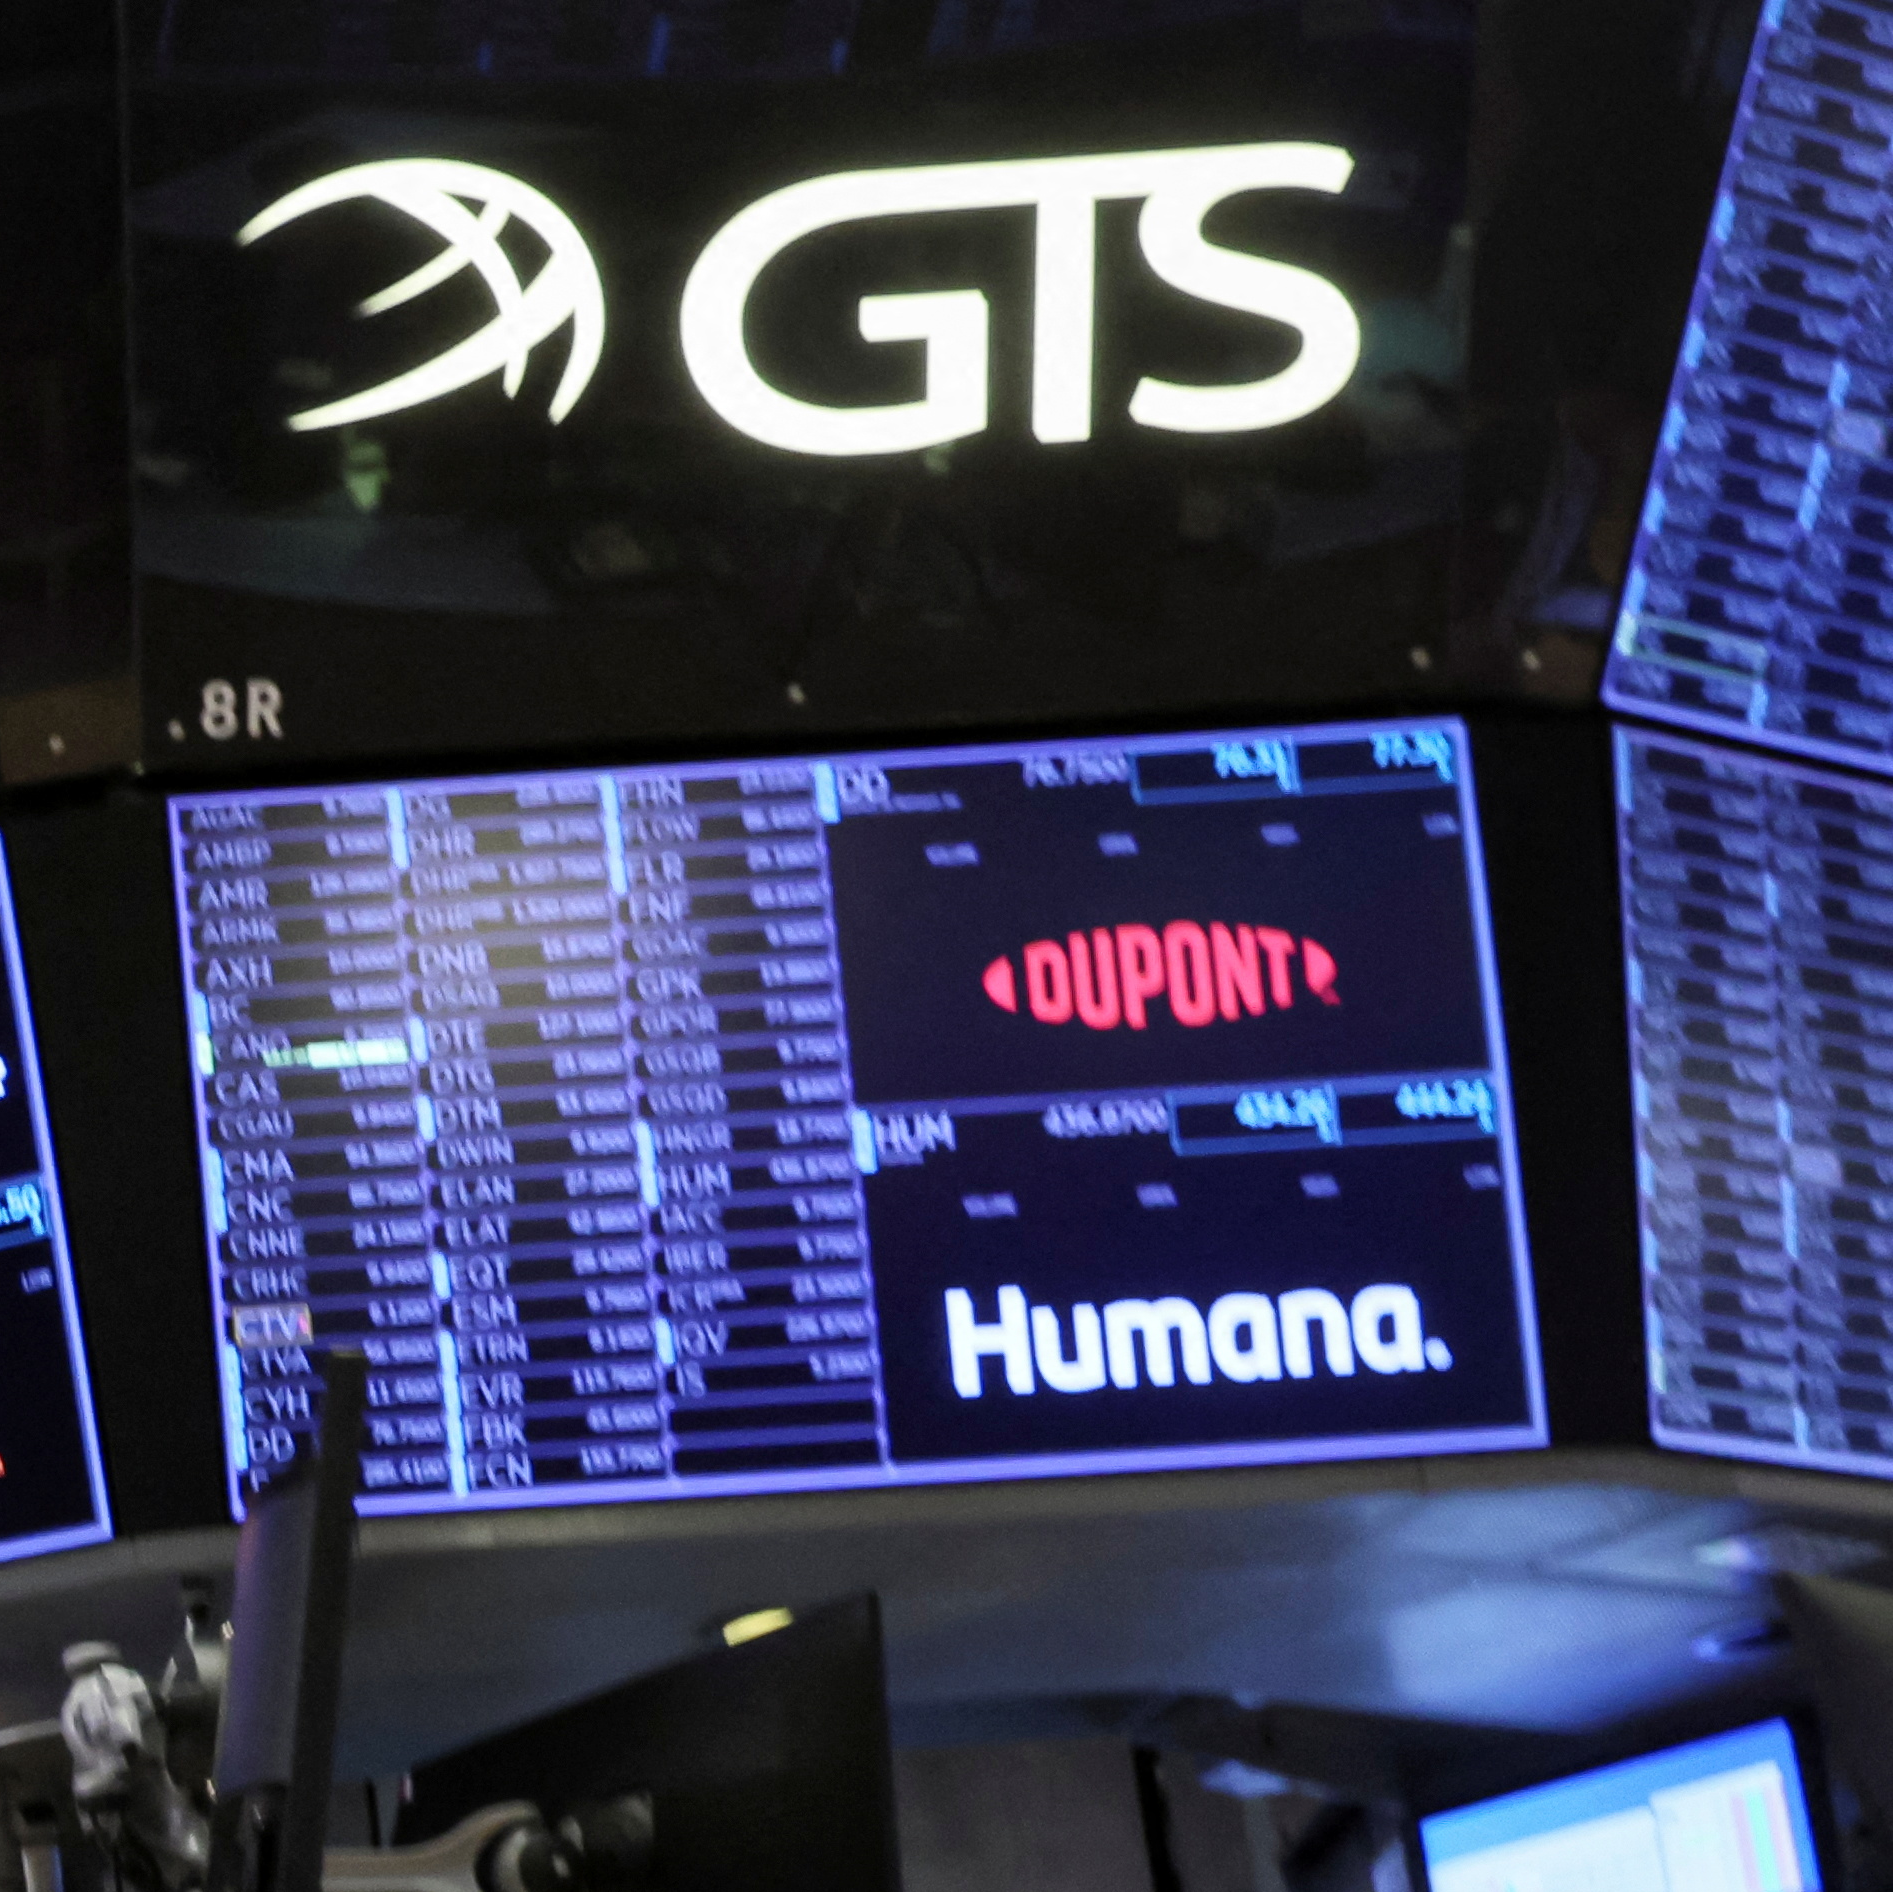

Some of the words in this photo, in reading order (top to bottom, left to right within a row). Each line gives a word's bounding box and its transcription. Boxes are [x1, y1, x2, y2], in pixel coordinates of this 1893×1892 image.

[679, 142, 1360, 456] GTS
[200, 676, 285, 738] 8R
[1023, 919, 1296, 1030] DUPONT
